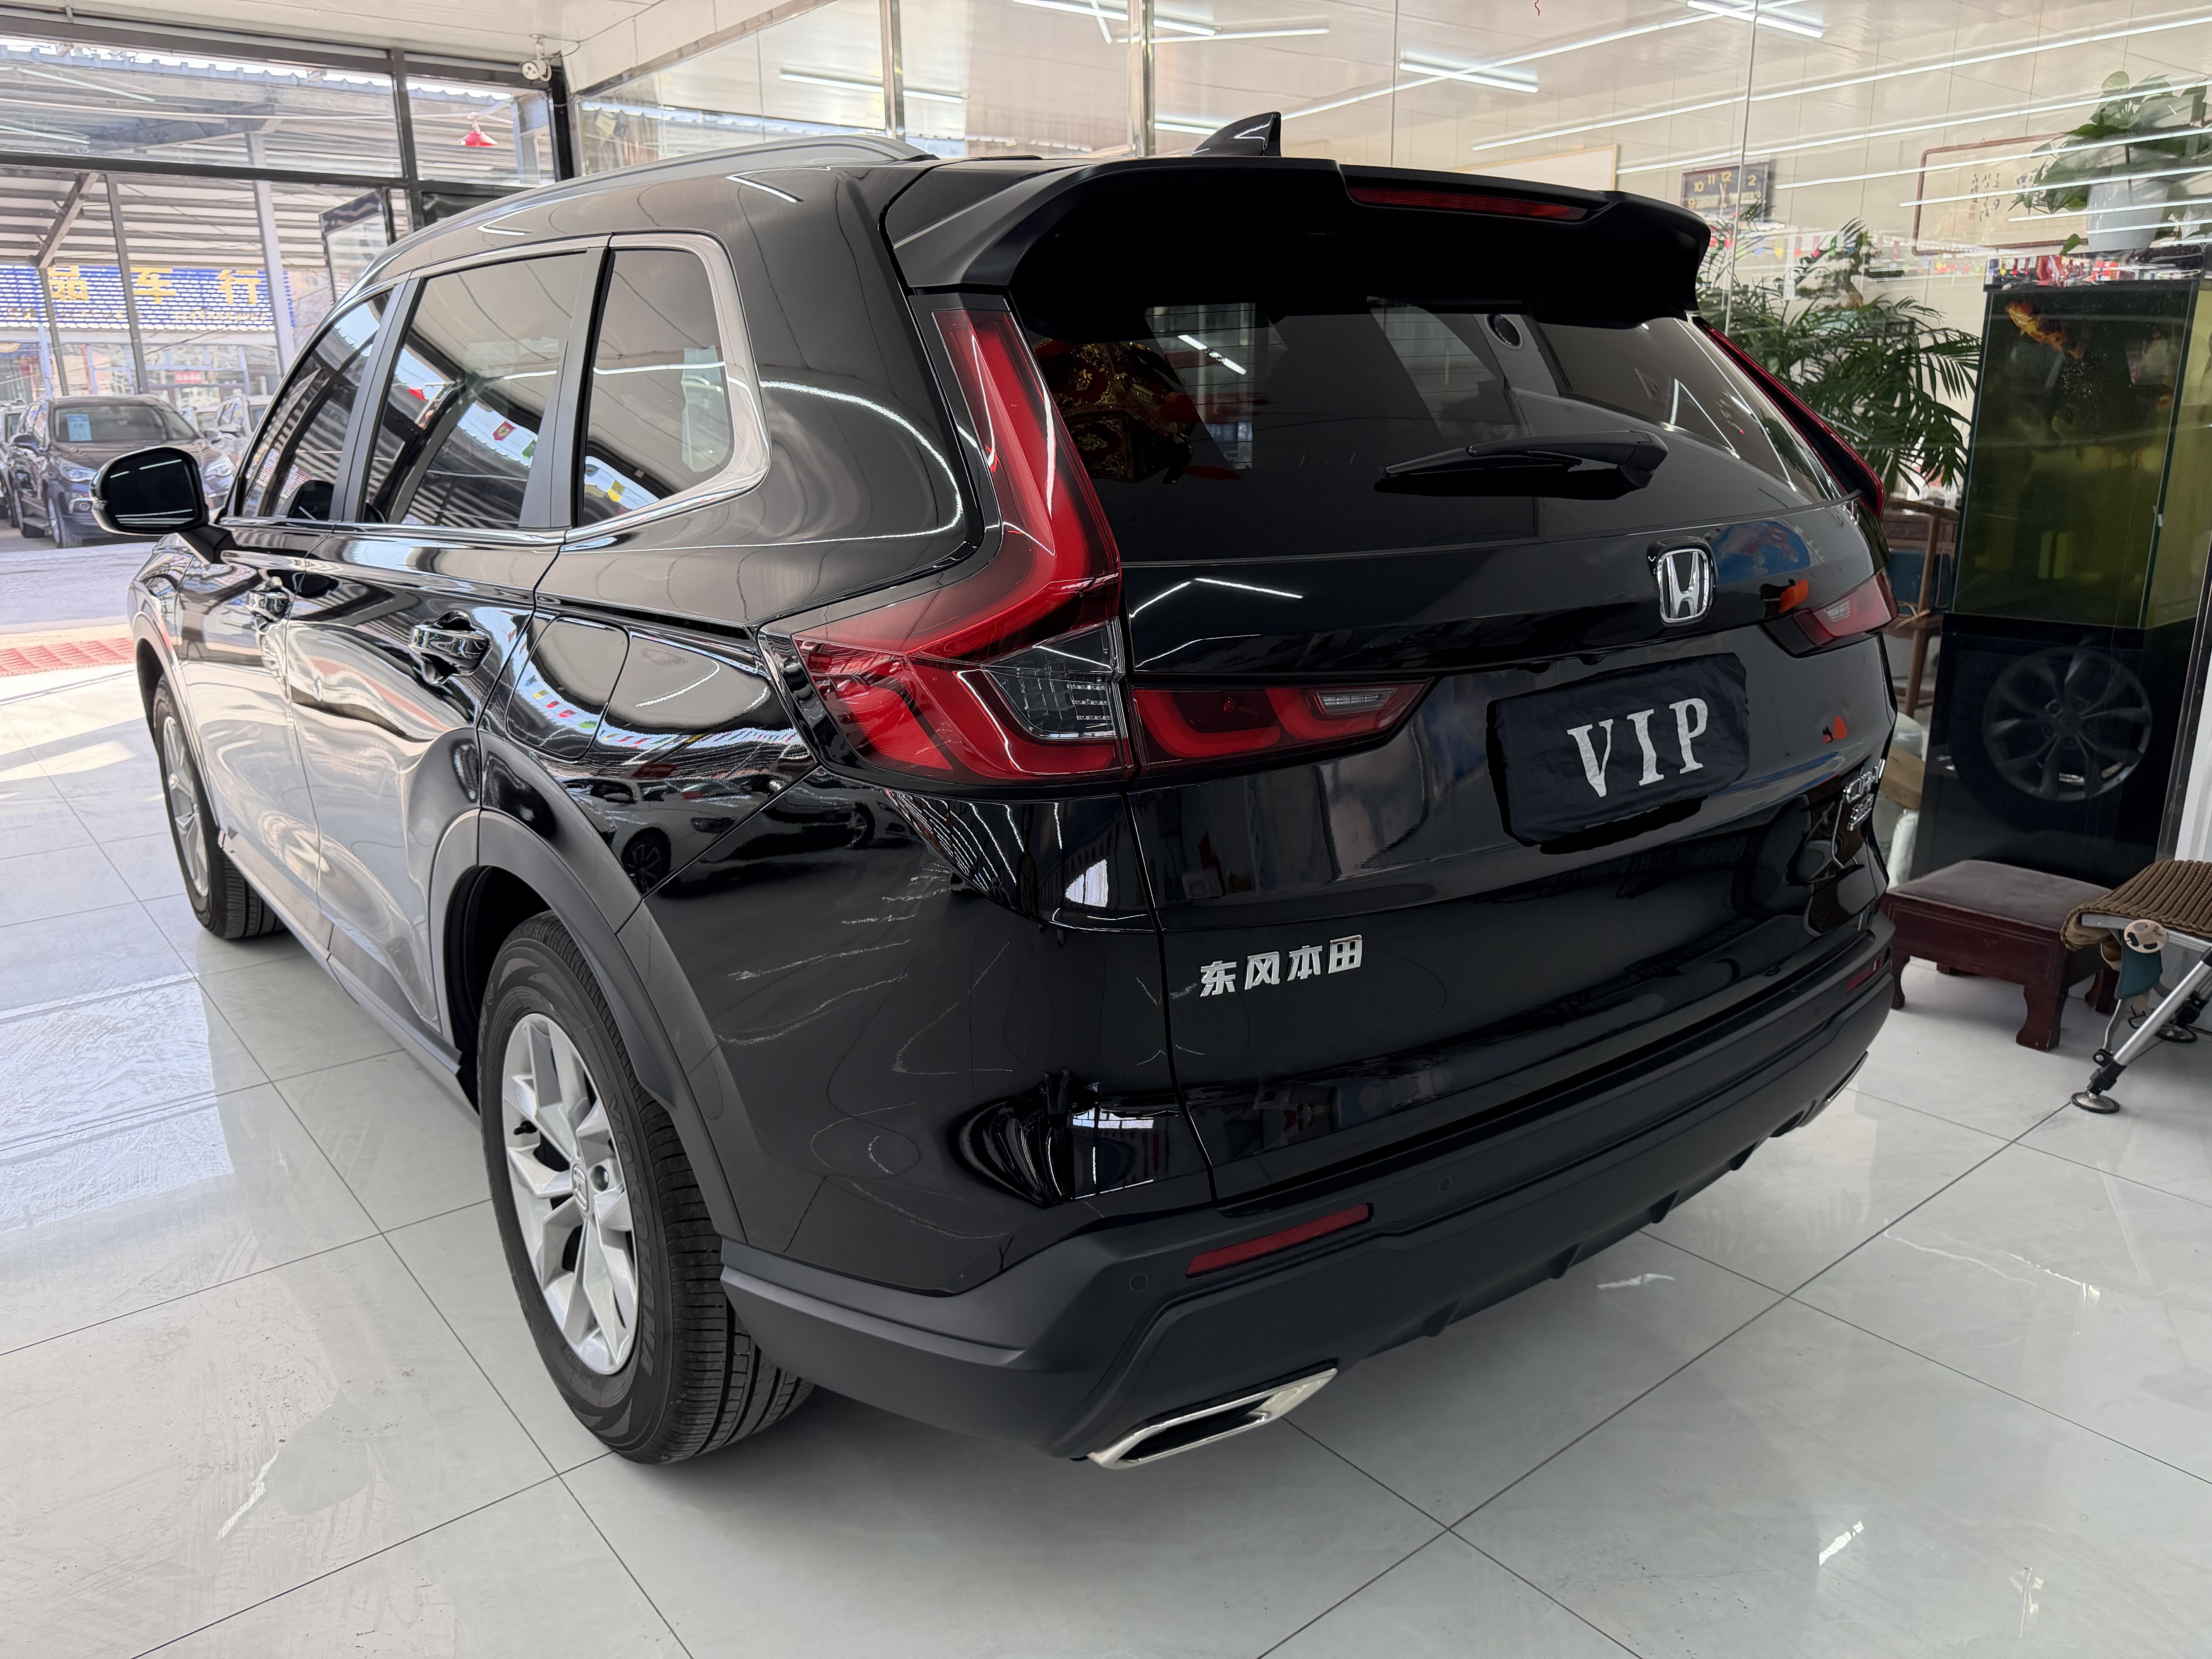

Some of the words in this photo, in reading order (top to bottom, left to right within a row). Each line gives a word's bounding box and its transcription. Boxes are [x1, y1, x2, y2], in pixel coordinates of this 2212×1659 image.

[1707, 173, 1716, 185] 11
[1721, 170, 1732, 182] 12
[1747, 174, 1757, 186] 2
[1693, 180, 1704, 193] 10
[1566, 697, 1709, 798] VIP
[1200, 934, 1363, 997] 东风本田
[606, 1093, 656, 1376] YOKOHAMA
